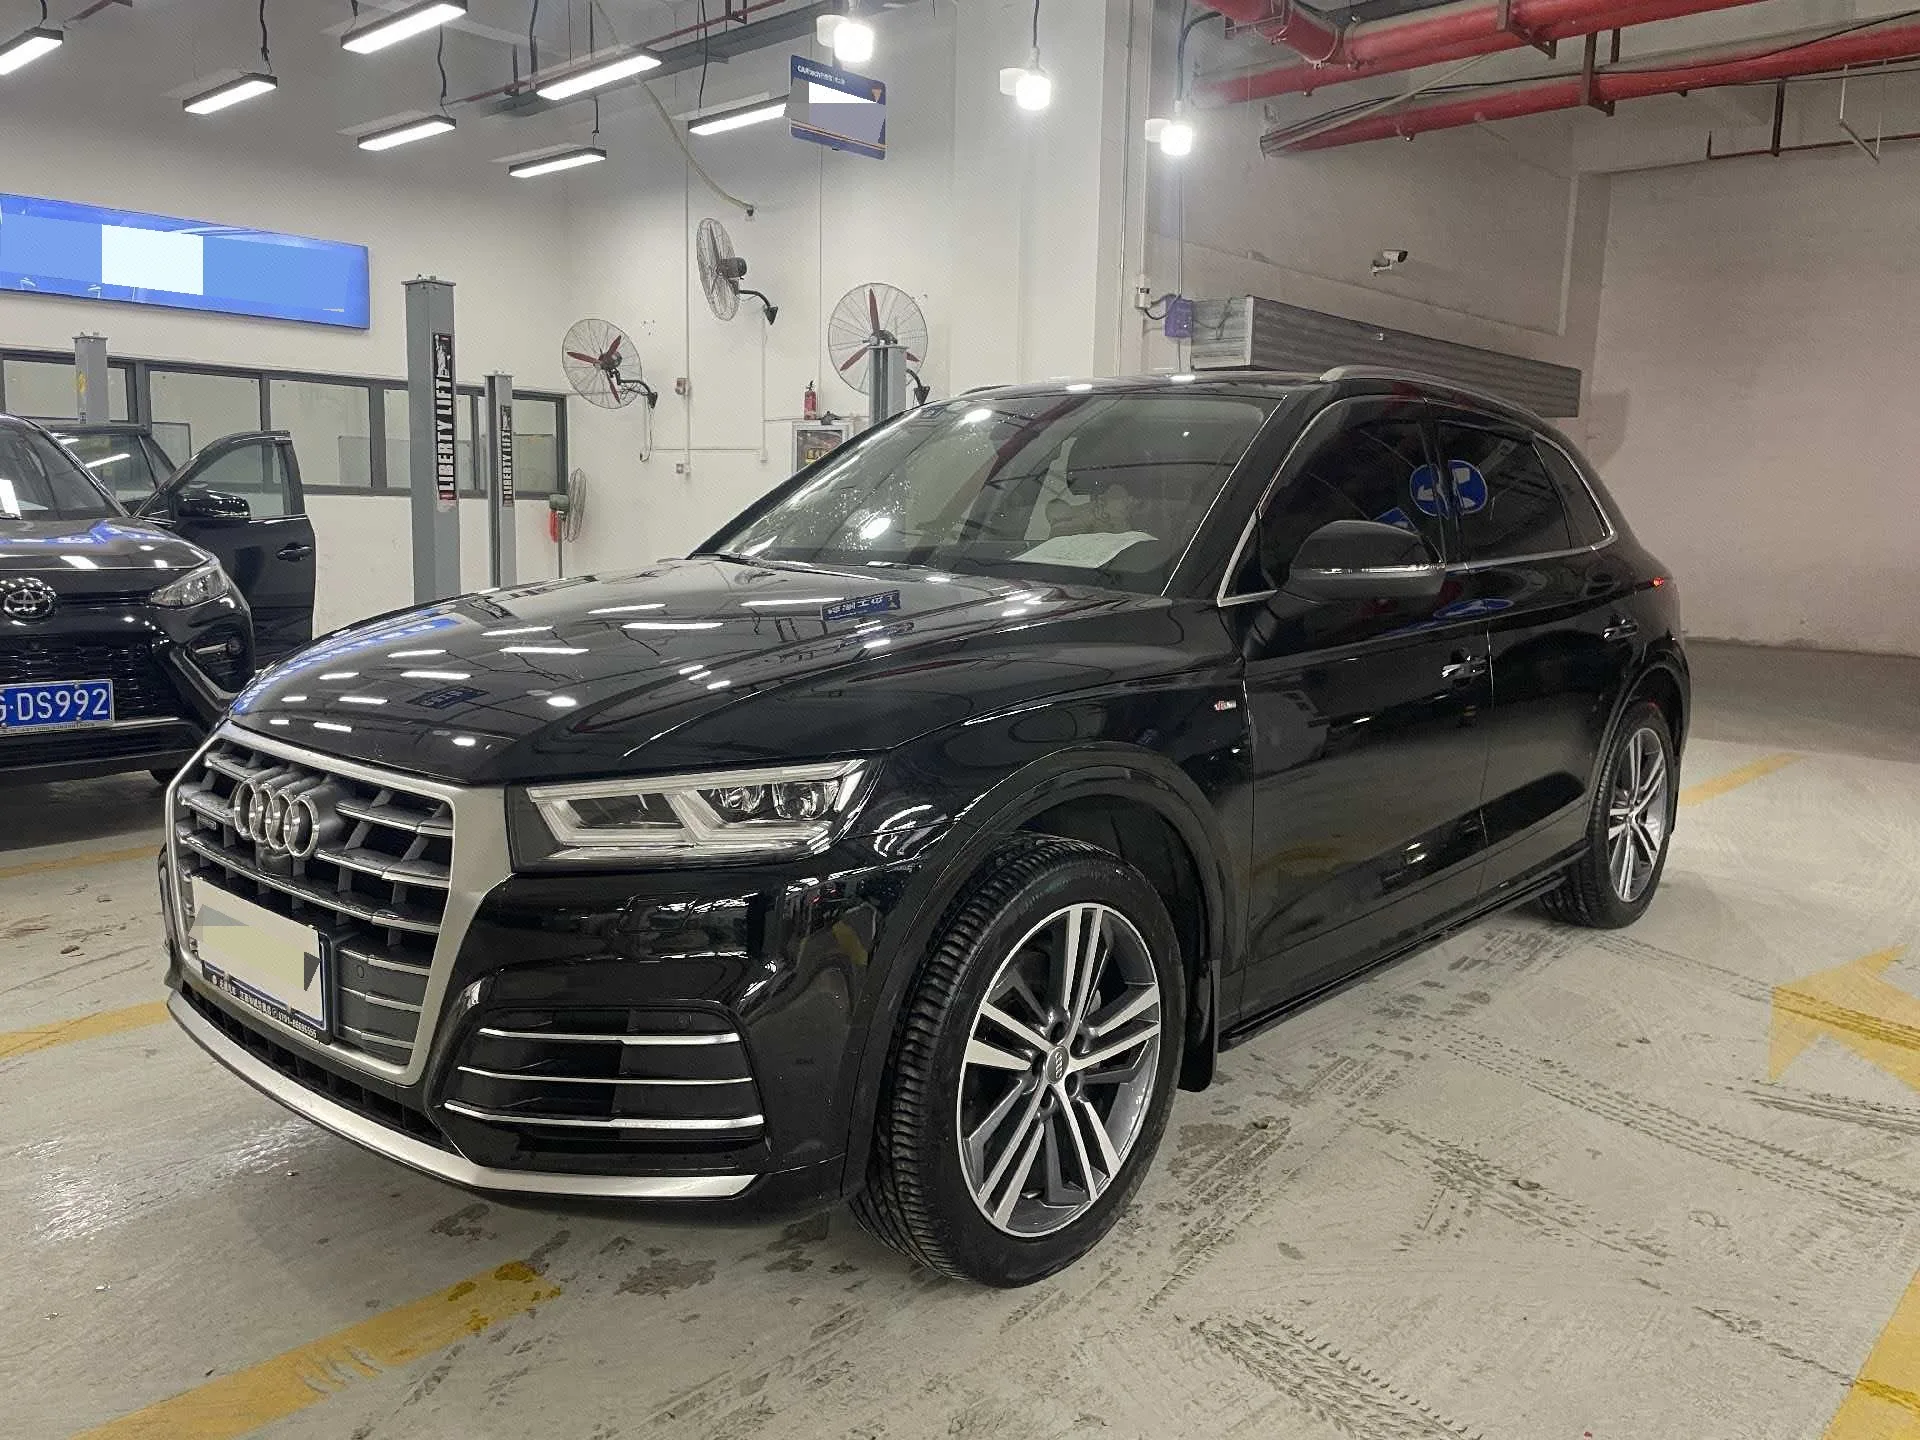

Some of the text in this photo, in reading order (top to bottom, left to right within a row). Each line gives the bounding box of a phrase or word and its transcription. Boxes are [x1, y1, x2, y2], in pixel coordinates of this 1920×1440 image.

[436, 378, 455, 491] LIBERTY LIFT
[502, 454, 513, 495] LIBERTY
